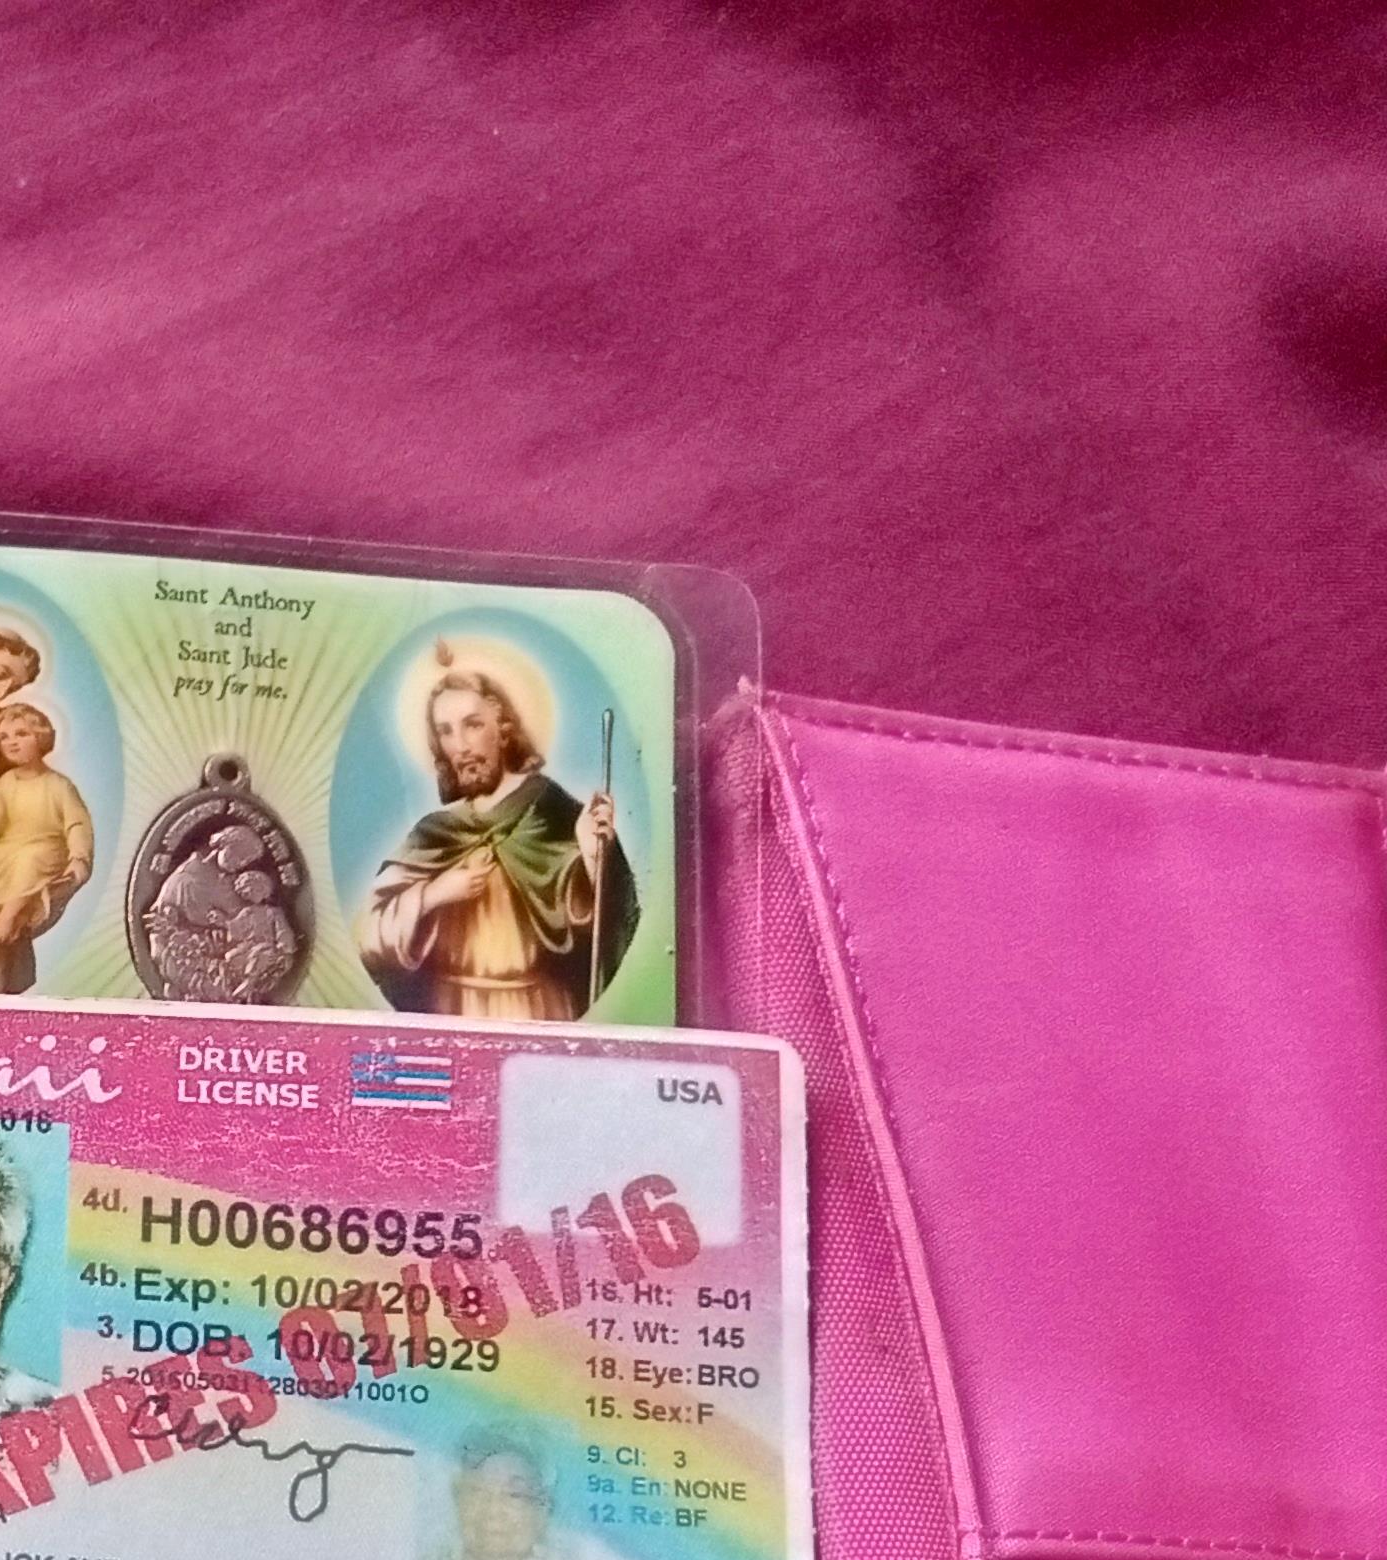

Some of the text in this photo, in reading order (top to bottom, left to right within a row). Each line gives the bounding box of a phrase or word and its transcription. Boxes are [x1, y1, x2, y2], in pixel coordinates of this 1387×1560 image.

[155, 580, 315, 620] Saint Anthony
[215, 617, 252, 638] and
[178, 640, 288, 670] Saint Jude
[174, 674, 287, 701] pray for me.
[179, 1045, 307, 1075] DRIVER
[178, 1079, 319, 1109] LICENSE
[657, 1078, 723, 1105] USA
[82, 1187, 483, 1258] 4d. H00686955
[80, 1262, 482, 1319] 4b. Exp: 10/02/2018
[634, 1283, 673, 1307] Ht:
[697, 1287, 752, 1311] 5-01
[97, 1315, 122, 1340] 3.
[266, 1330, 500, 1373] 10/02/1929
[585, 1318, 745, 1349] 17. Wt: 145
[585, 1356, 760, 1389] 18. Eye: BRO
[585, 1396, 714, 1424] 15. Sex: F
[673, 1450, 687, 1469] 3
[674, 1480, 747, 1501] NONE
[676, 1508, 708, 1528] BF
